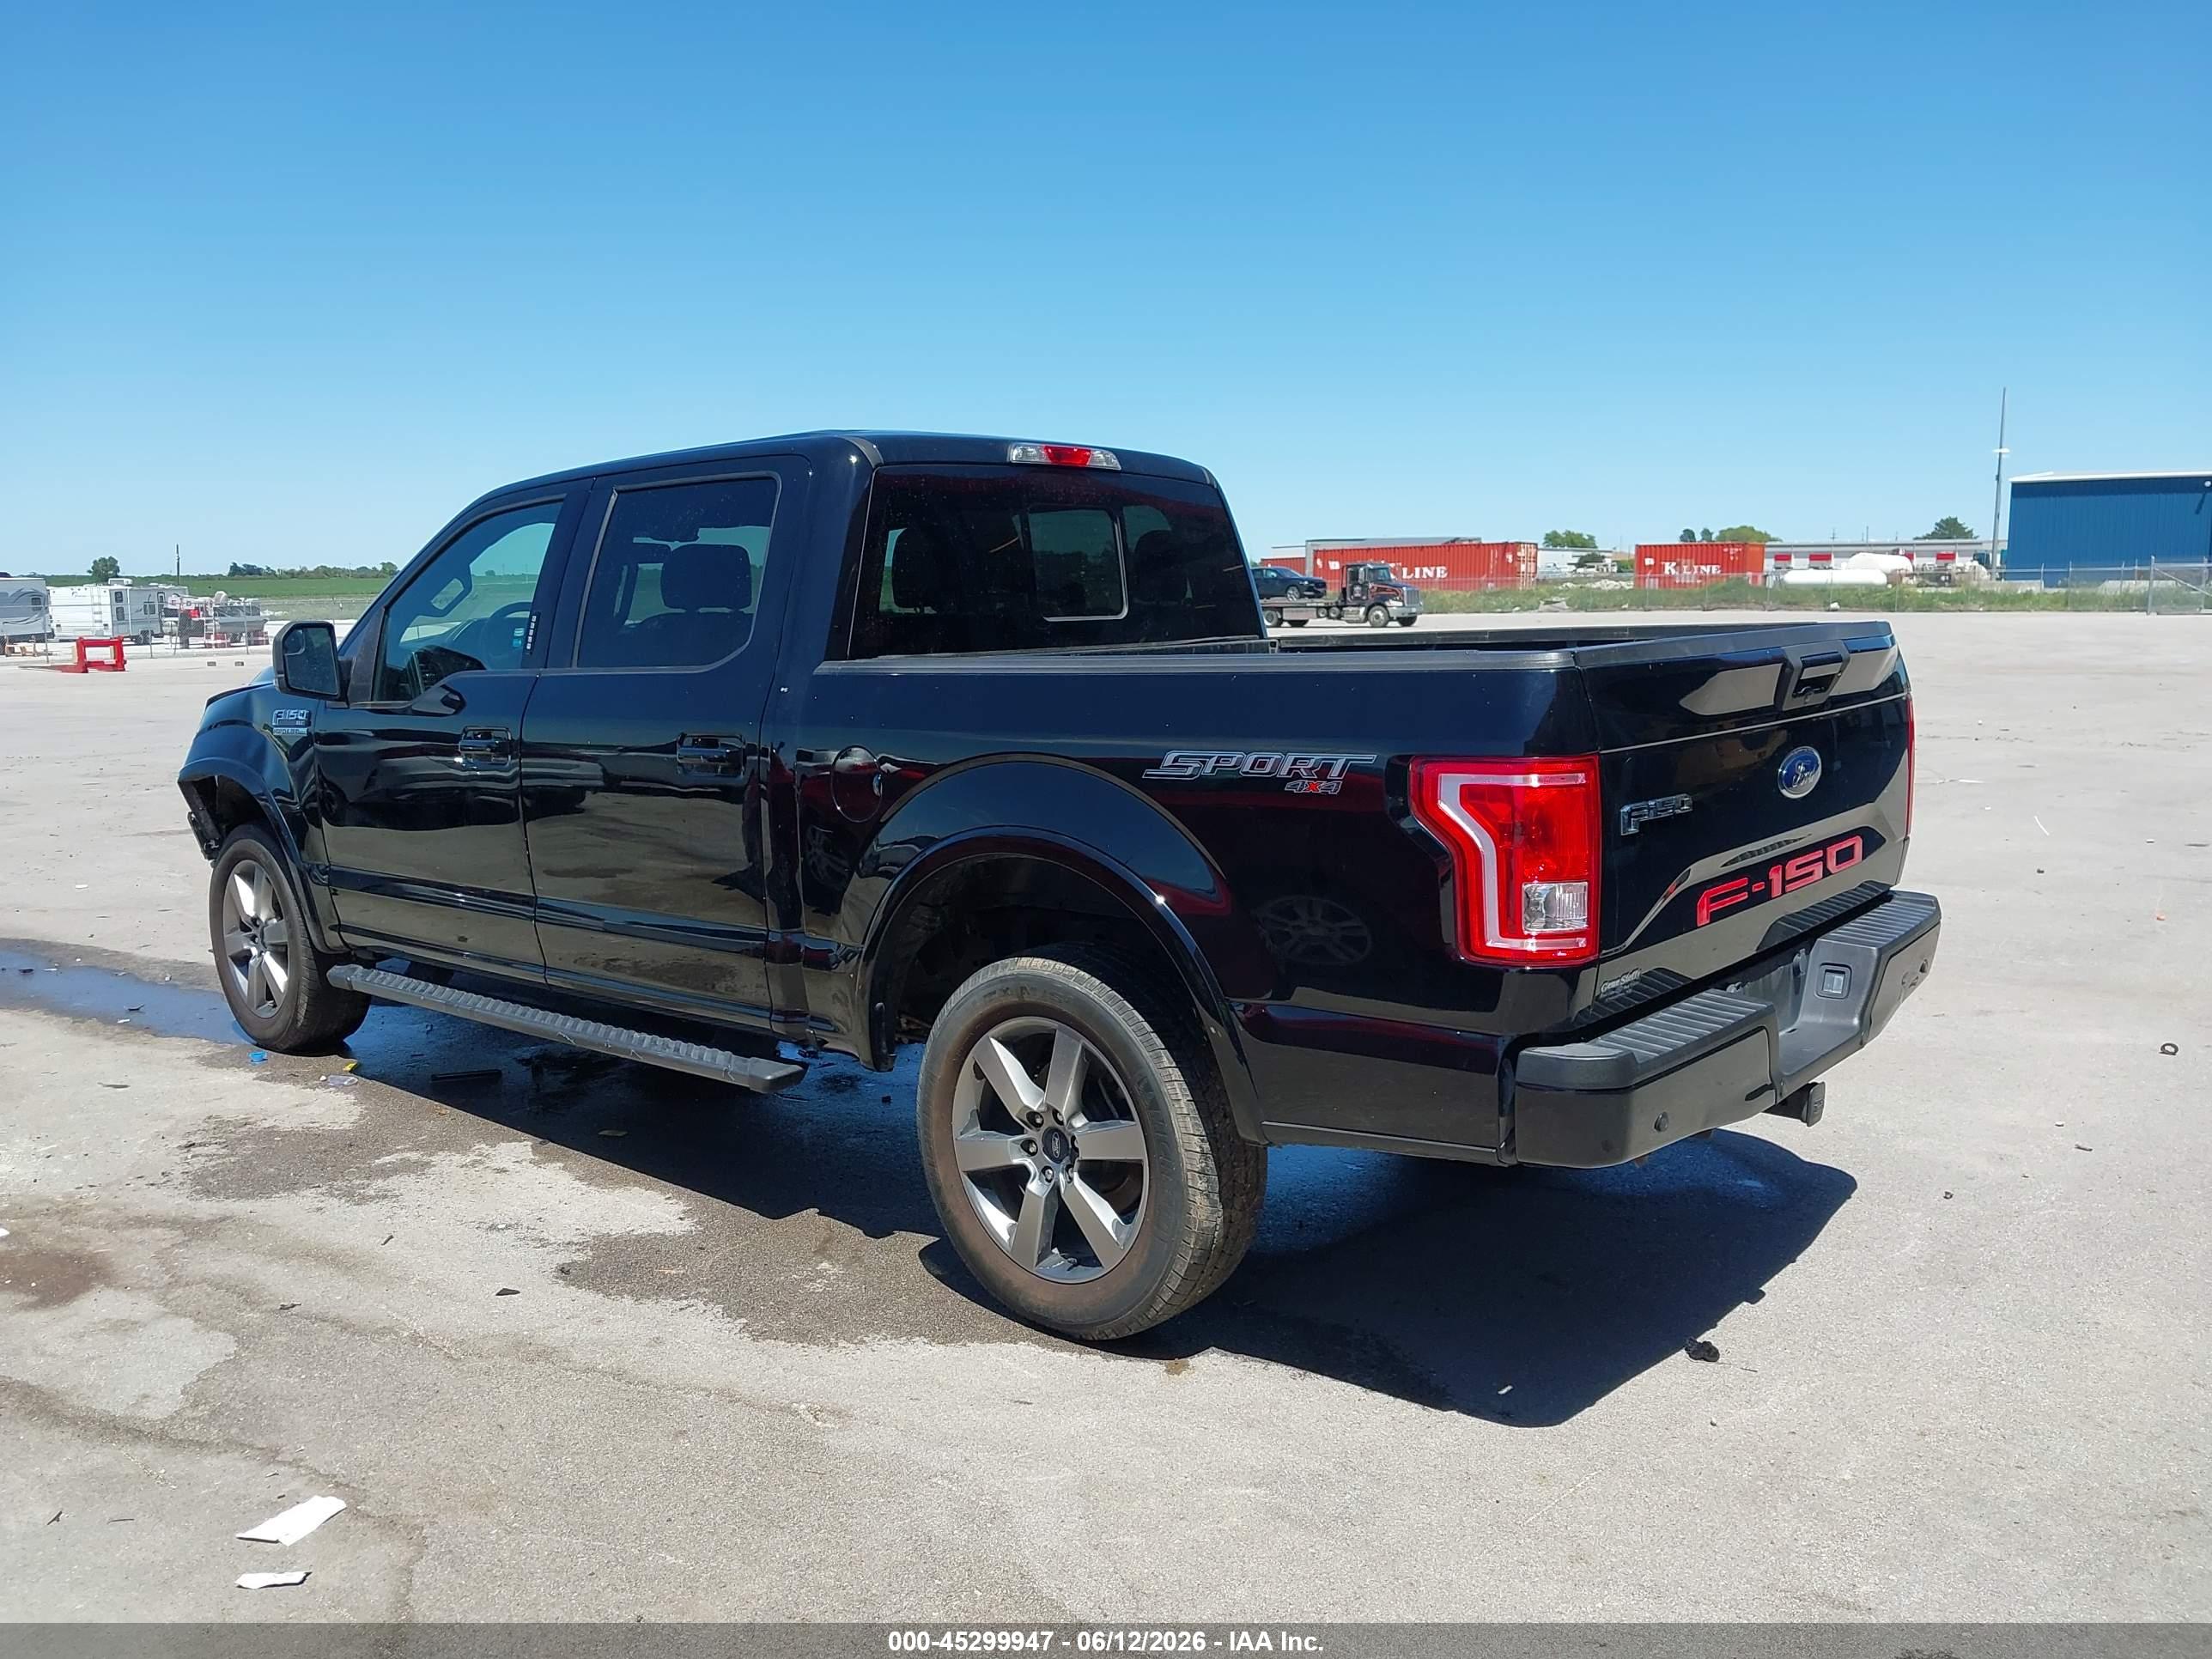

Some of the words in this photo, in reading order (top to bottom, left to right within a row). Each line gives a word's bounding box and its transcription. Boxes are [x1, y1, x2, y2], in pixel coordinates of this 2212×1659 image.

[1402, 565, 1449, 579] LINE
[1662, 562, 1677, 575] K
[1682, 564, 1722, 574] LINE
[1142, 750, 1377, 780] SPORT
[1696, 836, 1863, 927] F-150
